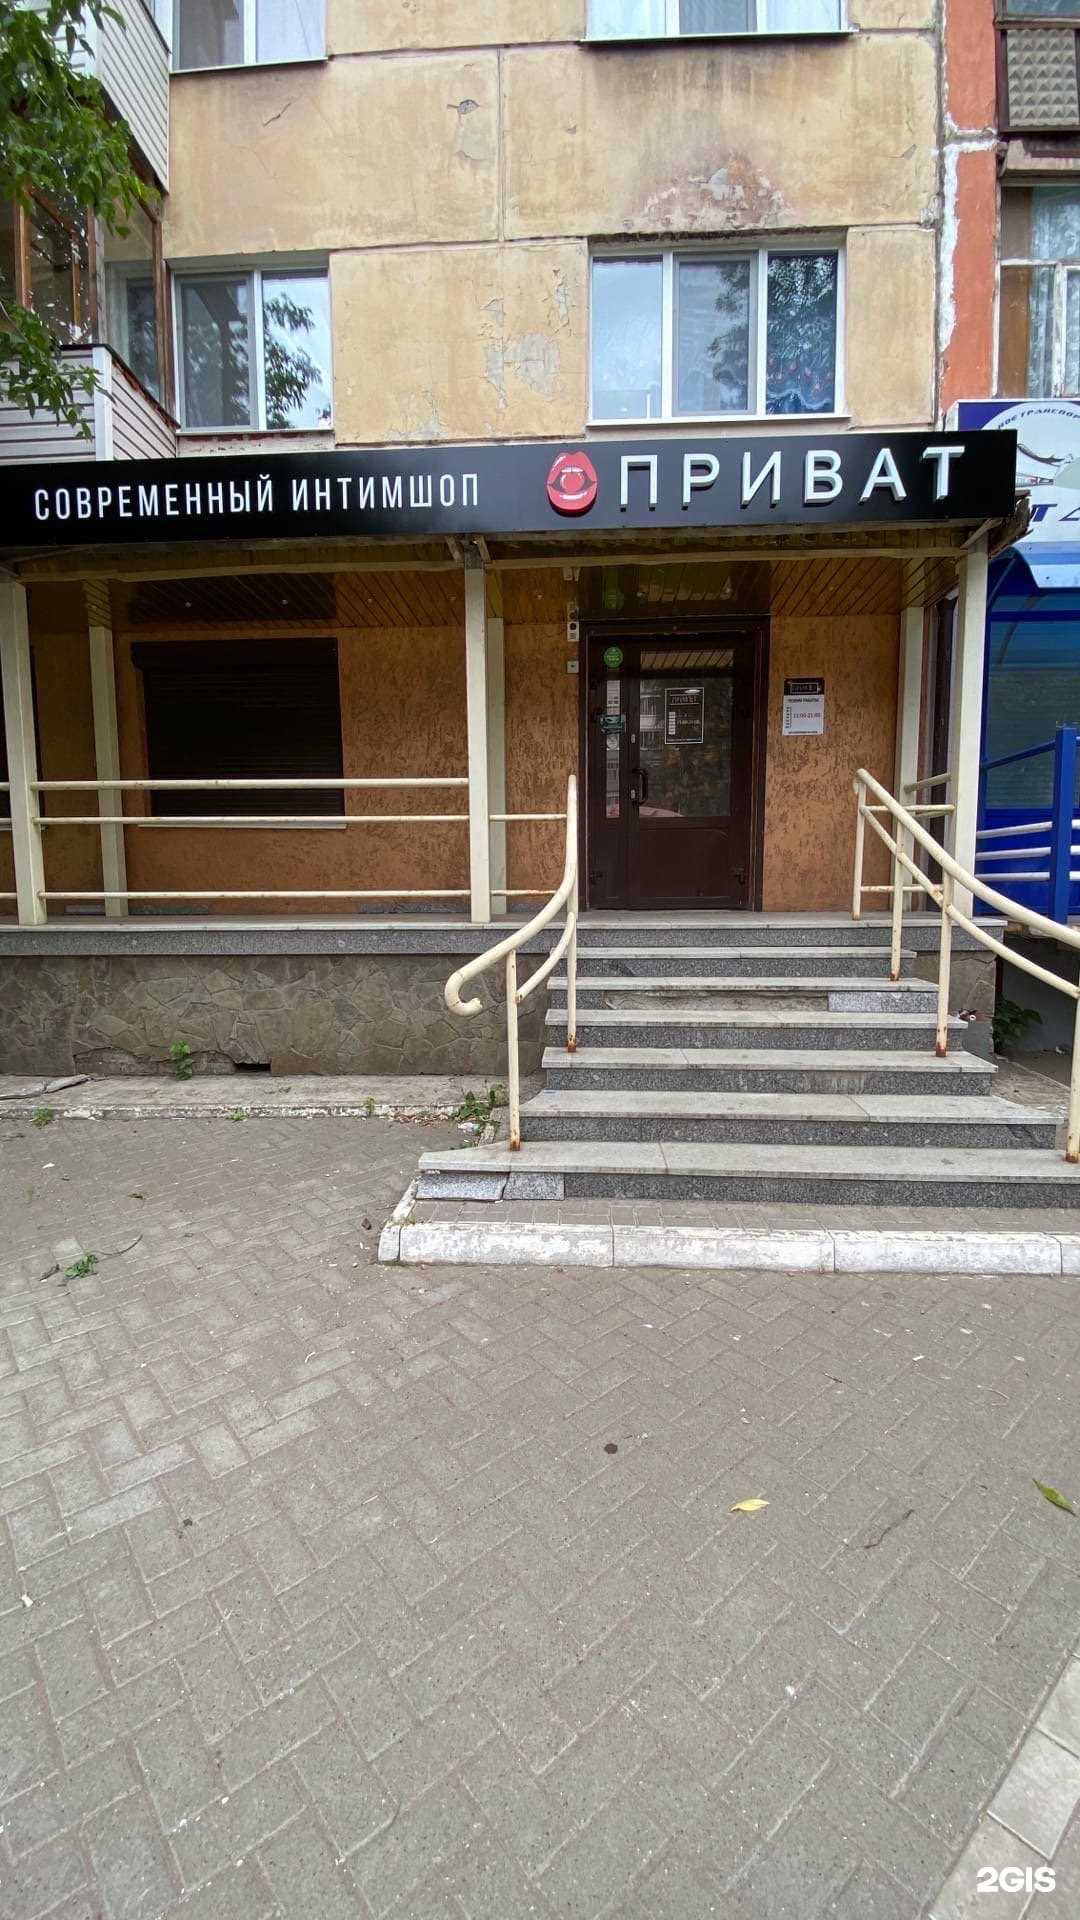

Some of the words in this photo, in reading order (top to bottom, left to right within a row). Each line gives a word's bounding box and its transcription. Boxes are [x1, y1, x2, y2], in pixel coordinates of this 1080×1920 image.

[34, 474, 275, 521] СОВРЕМЕННЫЙ
[292, 473, 480, 512] ИНТИМШОП
[620, 445, 967, 507] ПРИВАТ
